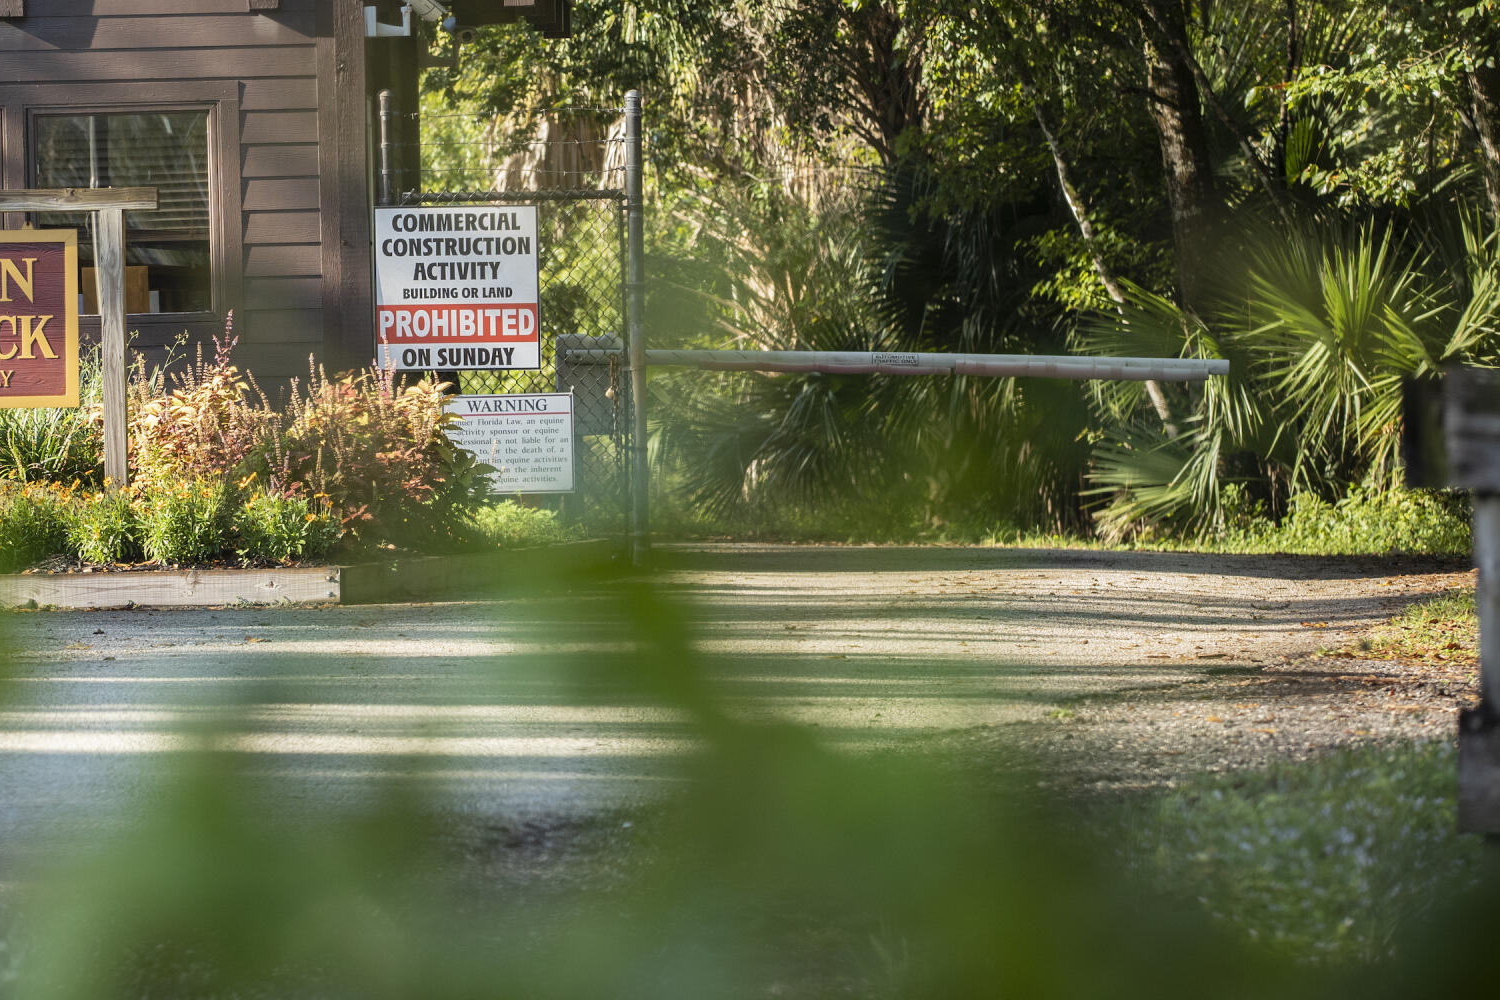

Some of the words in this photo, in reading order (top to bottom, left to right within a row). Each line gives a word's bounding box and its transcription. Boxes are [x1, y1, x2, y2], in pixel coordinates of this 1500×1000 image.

[391, 212, 521, 232] COMMERCIAL
[381, 236, 531, 257] CONSTRUCTION
[413, 261, 501, 281] ACTIVITY
[403, 287, 459, 299] BUILDING
[461, 287, 479, 299] OR
[482, 287, 513, 298] LAND
[379, 308, 535, 338] PROHIBITED
[402, 348, 431, 367] ON
[437, 347, 515, 366] SUNDAY
[467, 398, 548, 413] WARNING
[477, 418, 503, 426] Florida
[506, 418, 523, 426] Law,
[539, 417, 565, 426] equine
[456, 428, 486, 436] activity
[489, 428, 519, 436] sponsor
[534, 427, 559, 435] equine
[544, 436, 555, 444] for
[505, 446, 519, 454] the
[521, 446, 543, 454] death
[505, 457, 530, 465] equine
